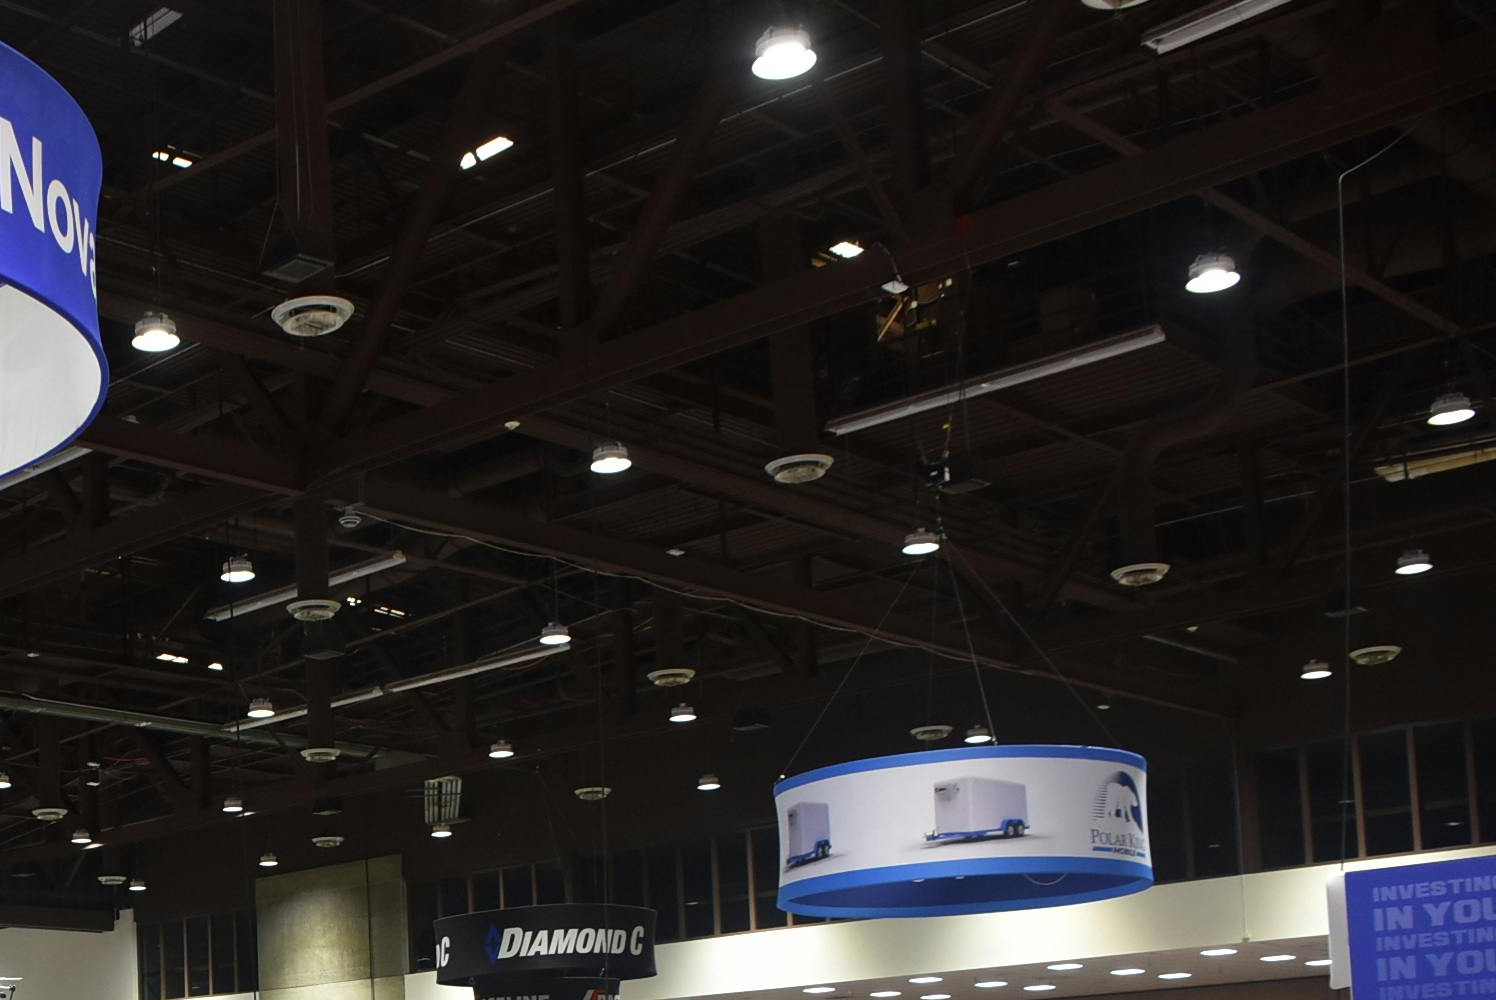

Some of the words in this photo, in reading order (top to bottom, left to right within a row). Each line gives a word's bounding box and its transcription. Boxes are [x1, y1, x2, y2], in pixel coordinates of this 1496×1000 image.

[1373, 905, 1414, 932] IN
[497, 926, 627, 960] DIAMOND
[630, 925, 645, 956] C
[1376, 955, 1417, 982] IN
